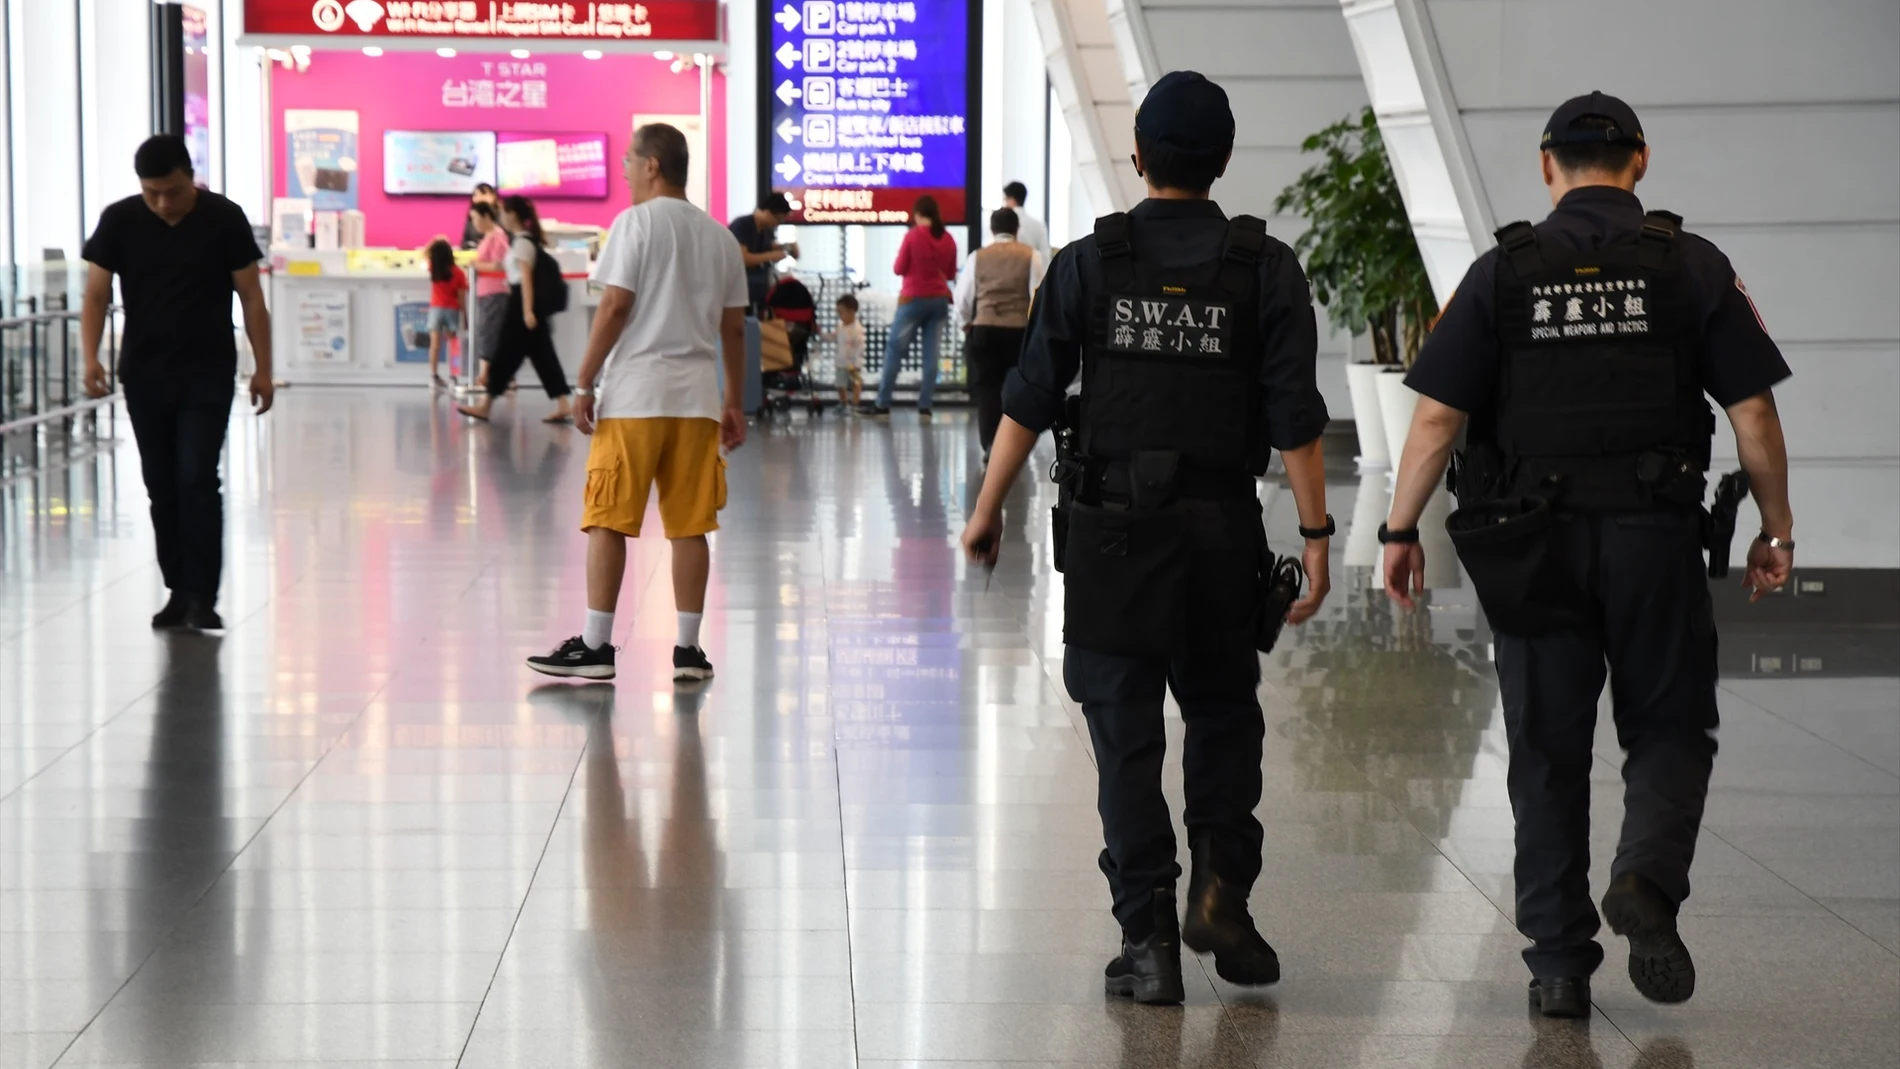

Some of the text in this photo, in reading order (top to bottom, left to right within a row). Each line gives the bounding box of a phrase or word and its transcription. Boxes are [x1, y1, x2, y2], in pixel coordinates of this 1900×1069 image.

[837, 21, 857, 35] Car
[858, 22, 887, 37] park
[498, 62, 547, 77] STAR
[837, 59, 857, 73] Car
[858, 60, 886, 75] park
[1115, 298, 1226, 330] S.W.A.T
[1531, 319, 1649, 340] SPECIAL WEAPONS AND TACTICS
